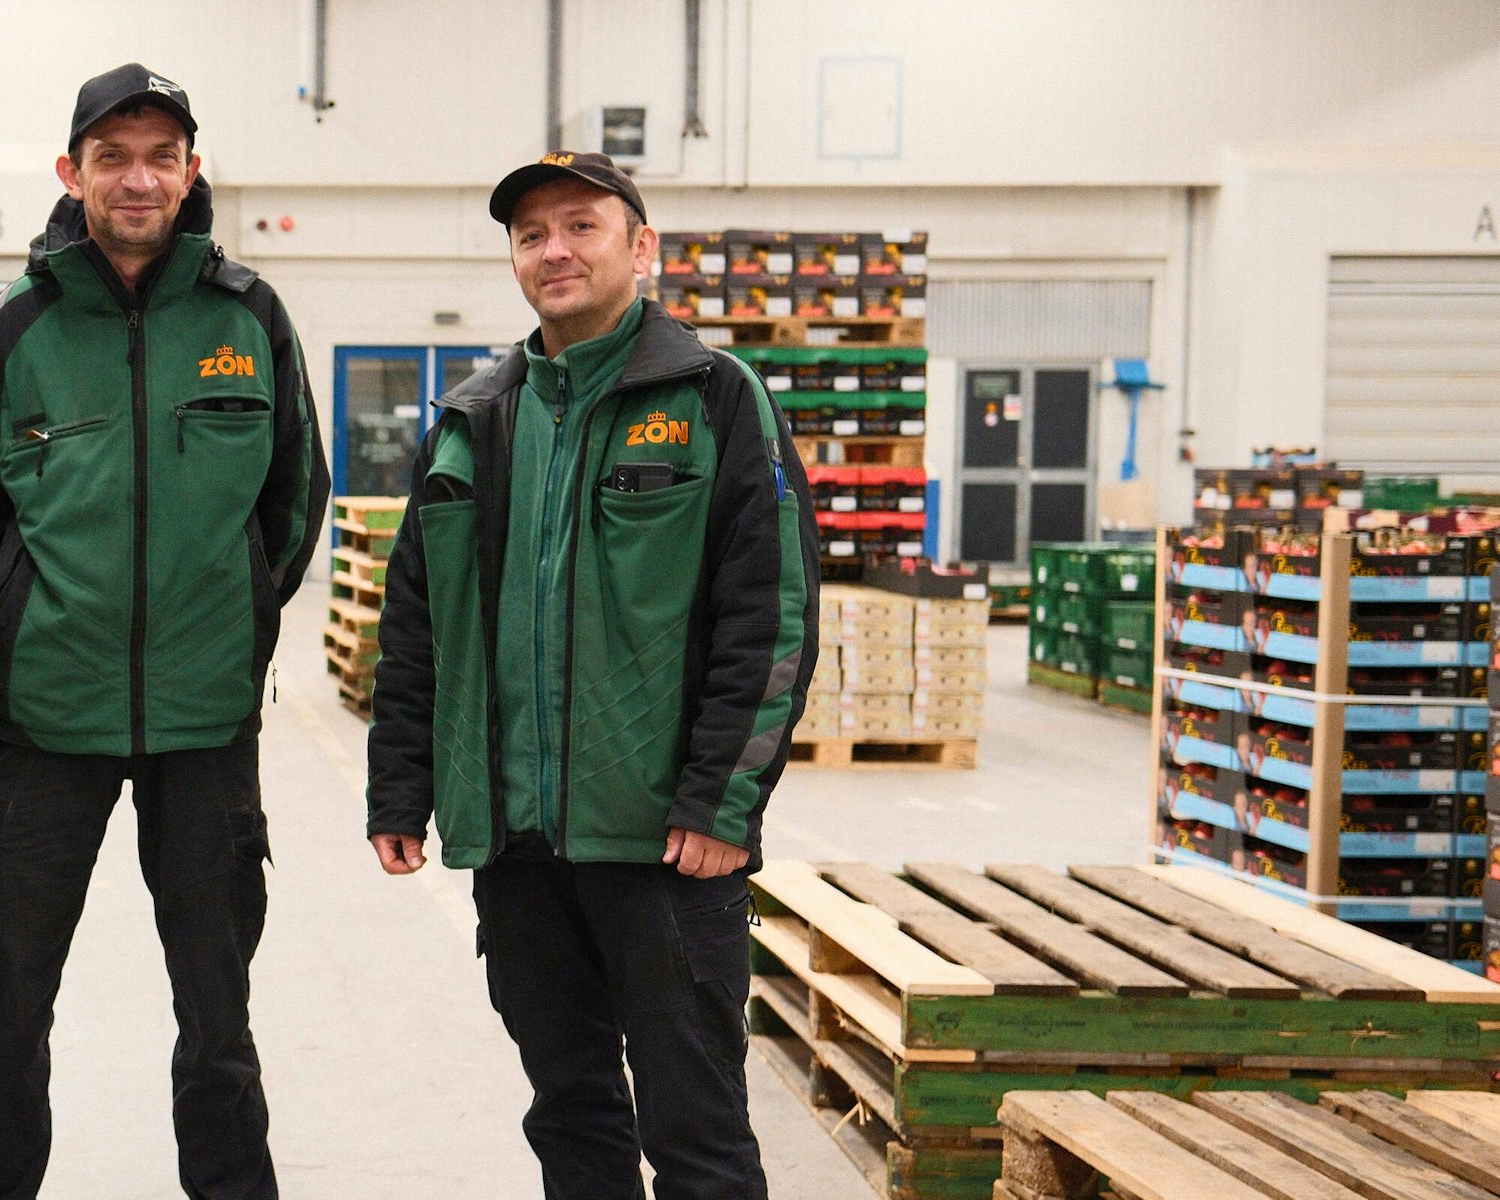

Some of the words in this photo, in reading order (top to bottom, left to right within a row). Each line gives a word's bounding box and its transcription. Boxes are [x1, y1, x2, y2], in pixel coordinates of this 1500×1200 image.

[1472, 205, 1497, 241] A
[198, 354, 255, 378] ZON
[626, 420, 689, 446] ZON
